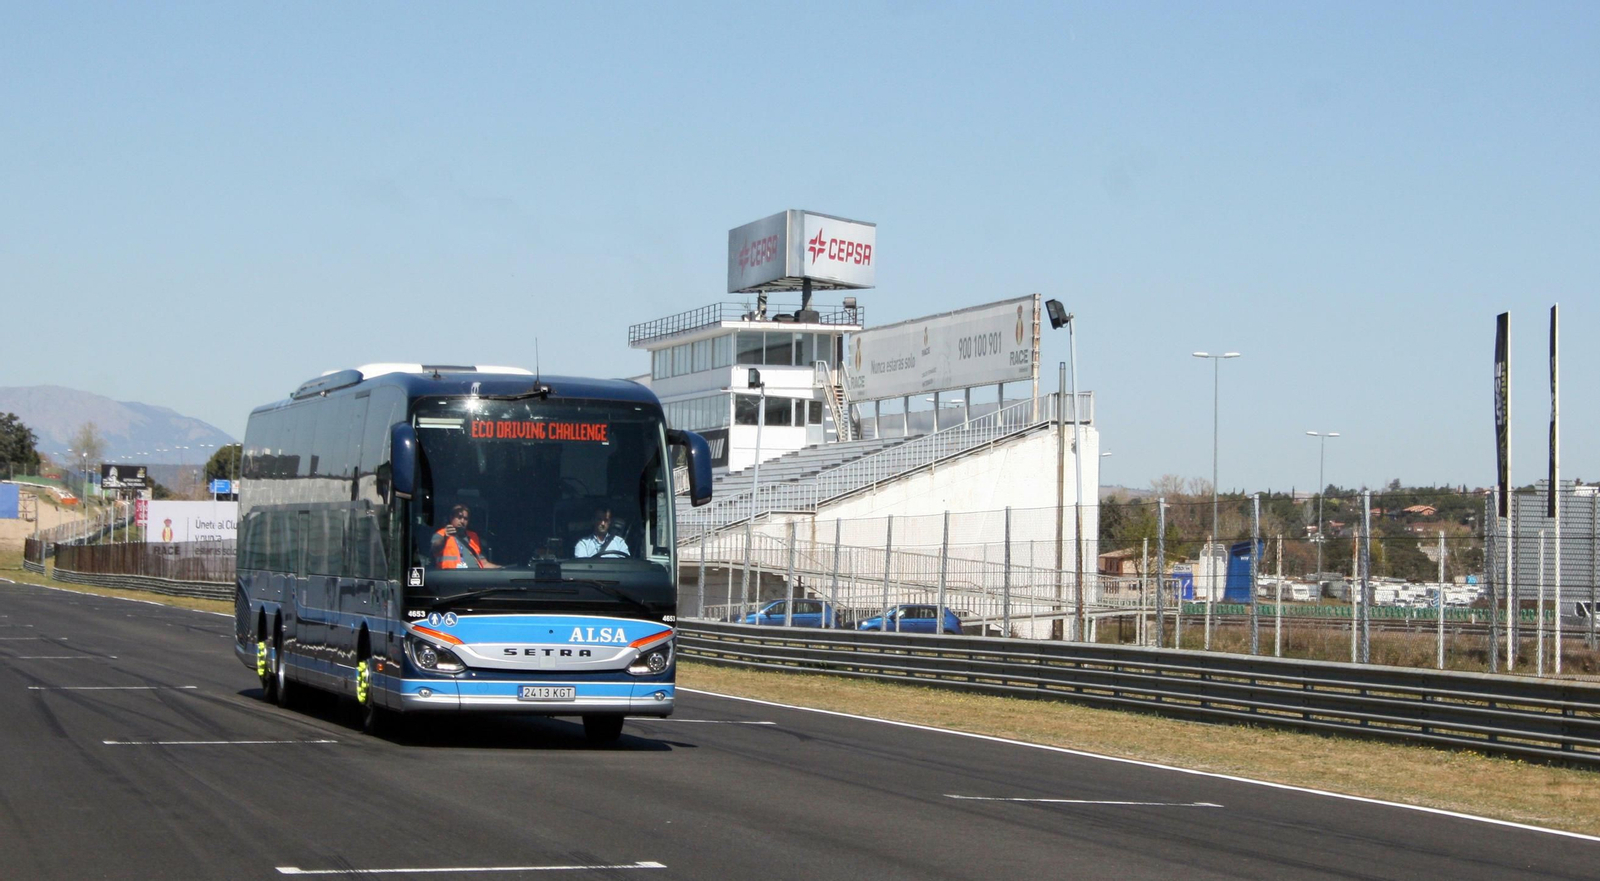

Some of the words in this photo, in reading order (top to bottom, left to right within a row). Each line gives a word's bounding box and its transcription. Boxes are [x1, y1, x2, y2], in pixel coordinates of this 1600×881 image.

[750, 234, 779, 267] CEPSA
[828, 238, 872, 266] CEPSA
[958, 337, 972, 361] 900
[974, 334, 987, 357] 100
[988, 331, 1002, 355] 901
[1009, 349, 1029, 366] RACE
[870, 360, 886, 375] Nunca
[471, 420, 494, 438] ECO
[496, 420, 546, 439] DRIVING
[548, 422, 608, 441] CHALLENGE
[218, 520, 225, 530] al
[226, 520, 238, 530] Clu
[153, 546, 180, 556] RACE
[408, 610, 426, 618] 4653
[568, 626, 628, 643] ALSA
[503, 648, 592, 657] SETRA
[524, 687, 550, 698] 2413
[552, 688, 572, 698] KGT
